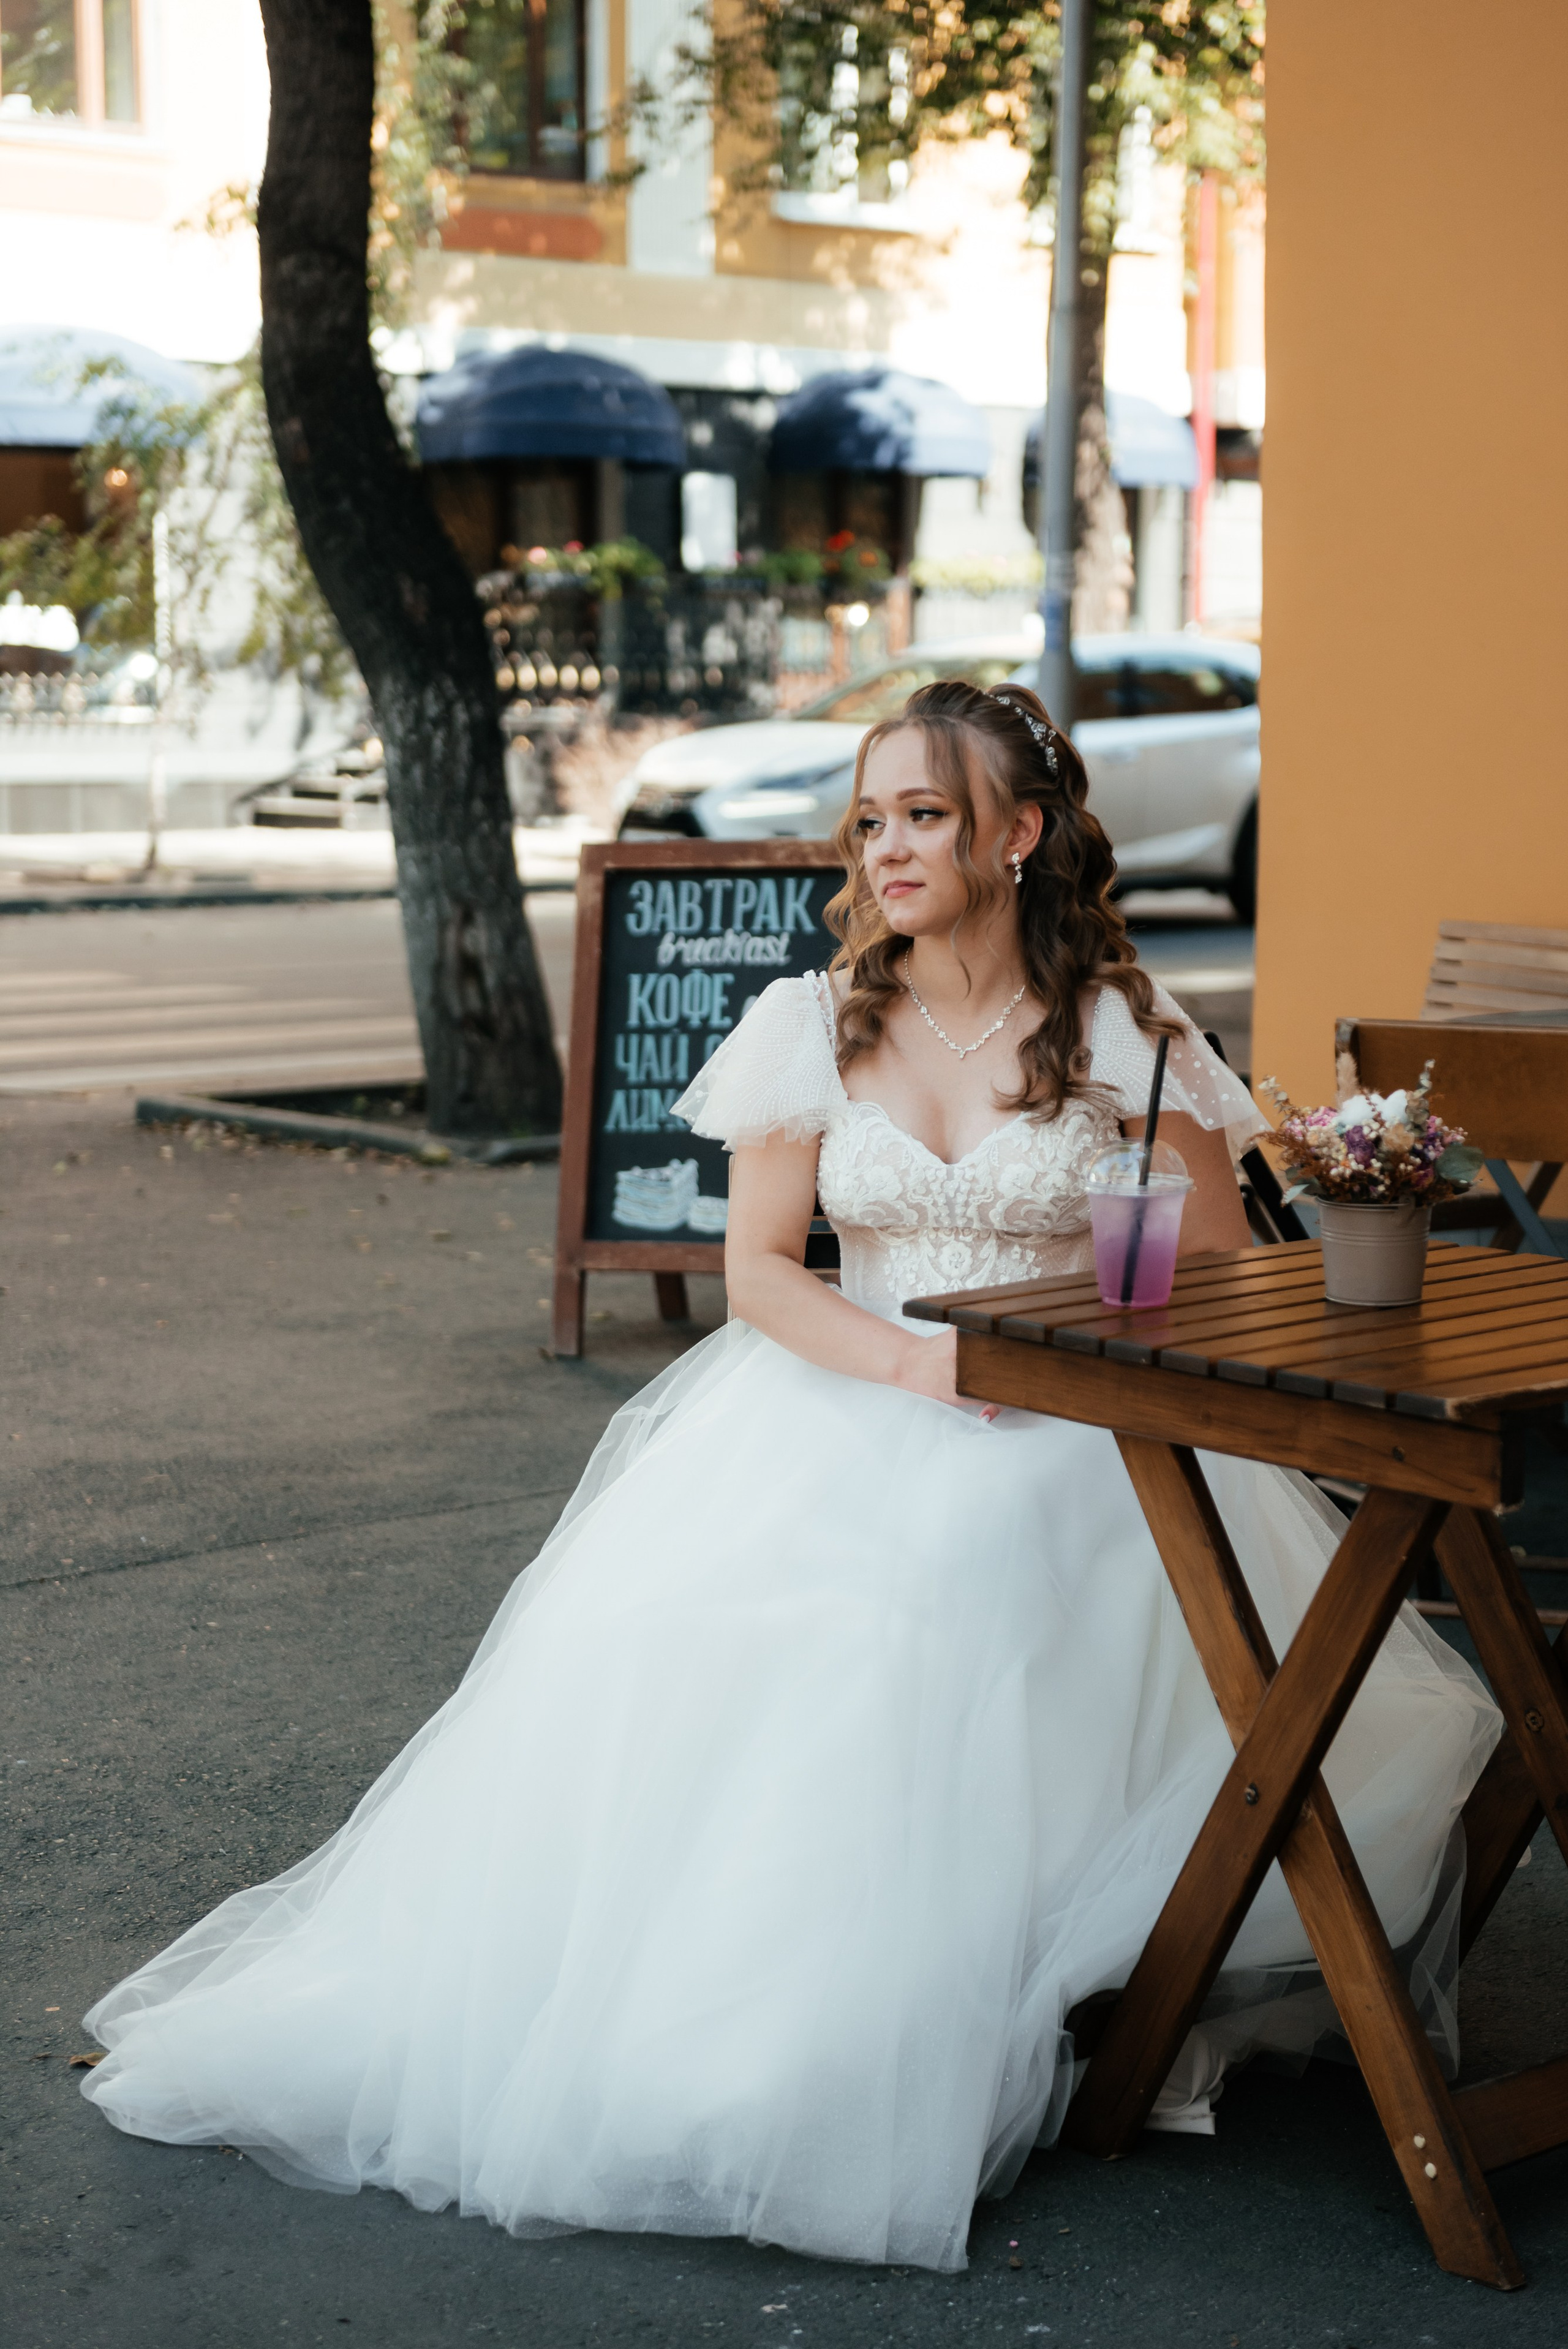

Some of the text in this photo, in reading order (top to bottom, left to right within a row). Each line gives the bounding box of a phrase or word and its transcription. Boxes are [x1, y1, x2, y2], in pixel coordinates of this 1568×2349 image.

[625, 877, 817, 937] ЗАВТРАК
[625, 968, 735, 1029] КОФЕ
[615, 1029, 689, 1084] ЧАЙ
